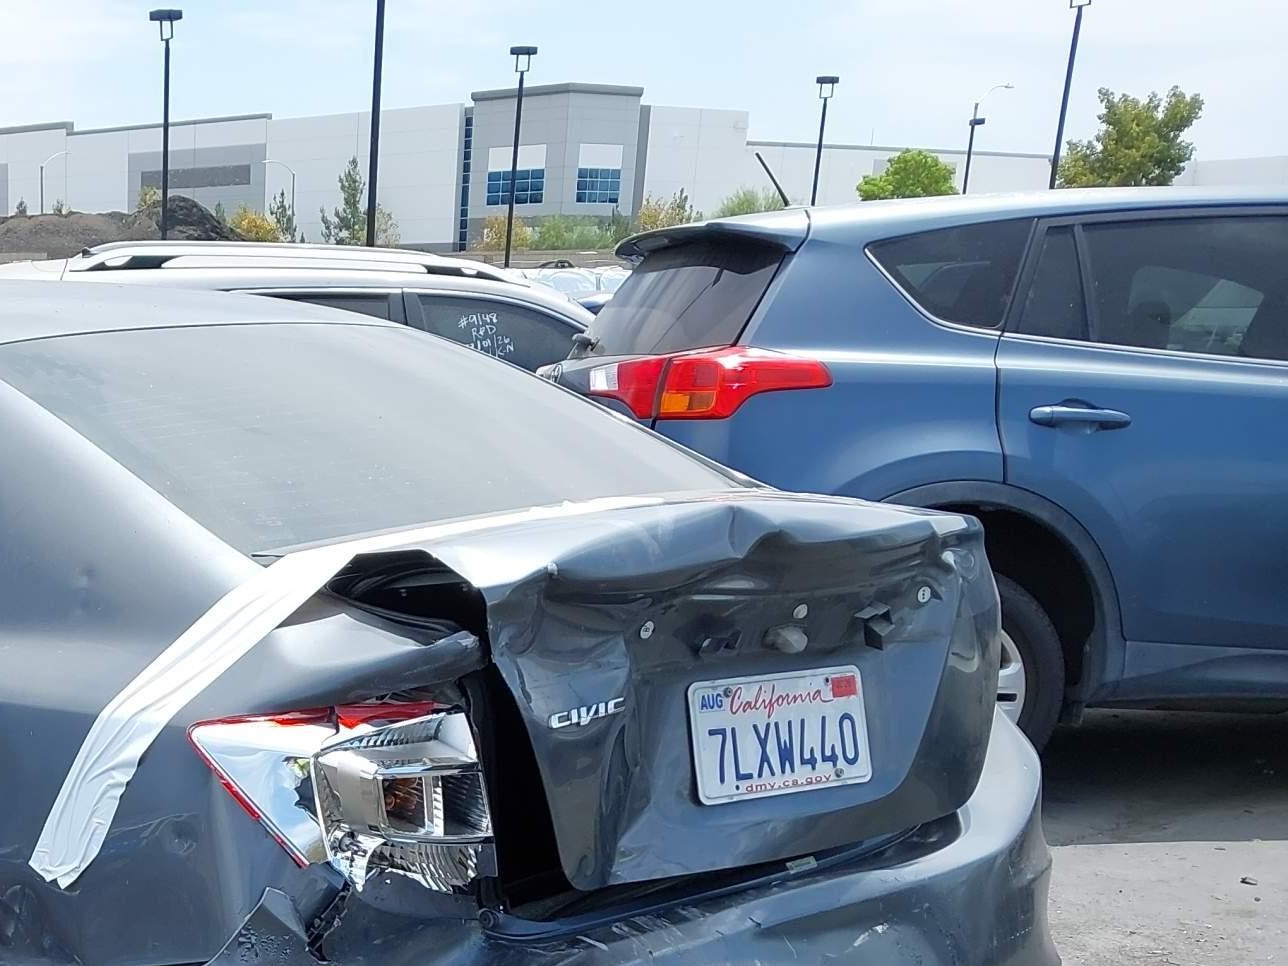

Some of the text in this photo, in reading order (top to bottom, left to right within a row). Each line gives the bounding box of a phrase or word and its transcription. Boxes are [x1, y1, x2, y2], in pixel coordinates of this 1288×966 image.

[548, 697, 626, 728] CIVIC
[700, 684, 834, 719] AUG California
[707, 712, 860, 785] 7LXW440
[745, 773, 832, 793] dmv.ca.gov
